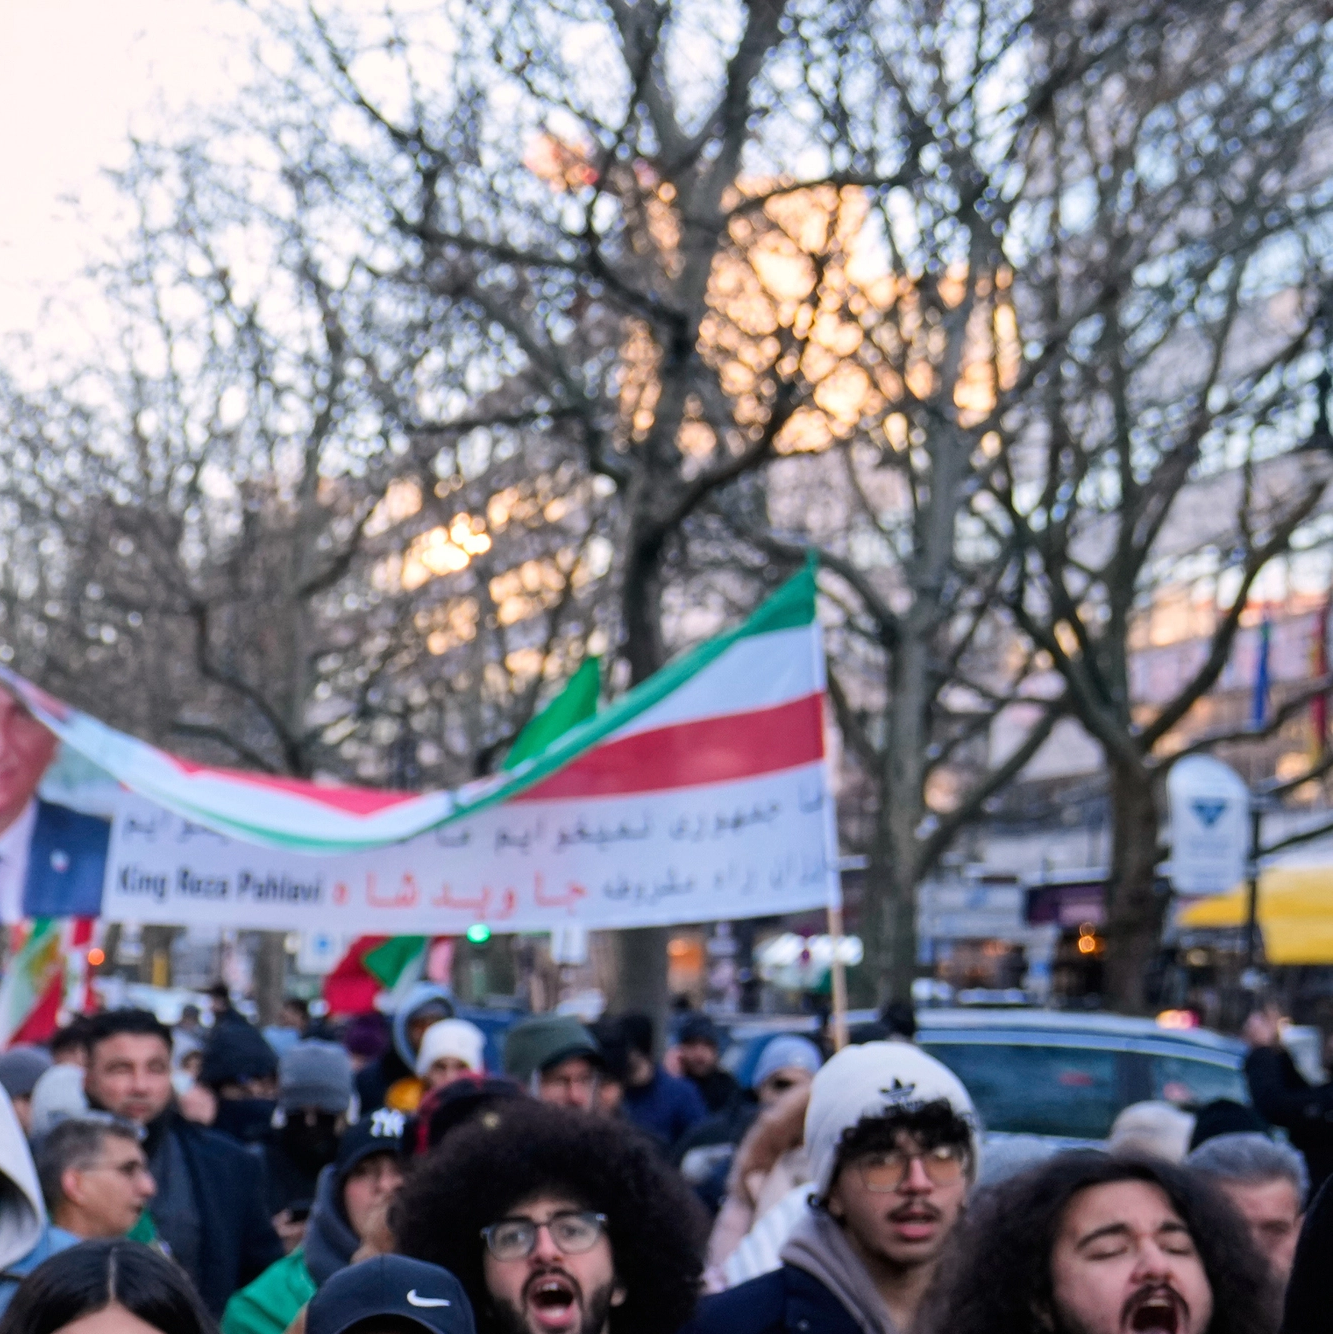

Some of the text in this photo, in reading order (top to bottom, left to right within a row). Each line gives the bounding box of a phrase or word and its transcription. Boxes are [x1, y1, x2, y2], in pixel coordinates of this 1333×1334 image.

[116, 864, 327, 905] King Reza Pahlavi
